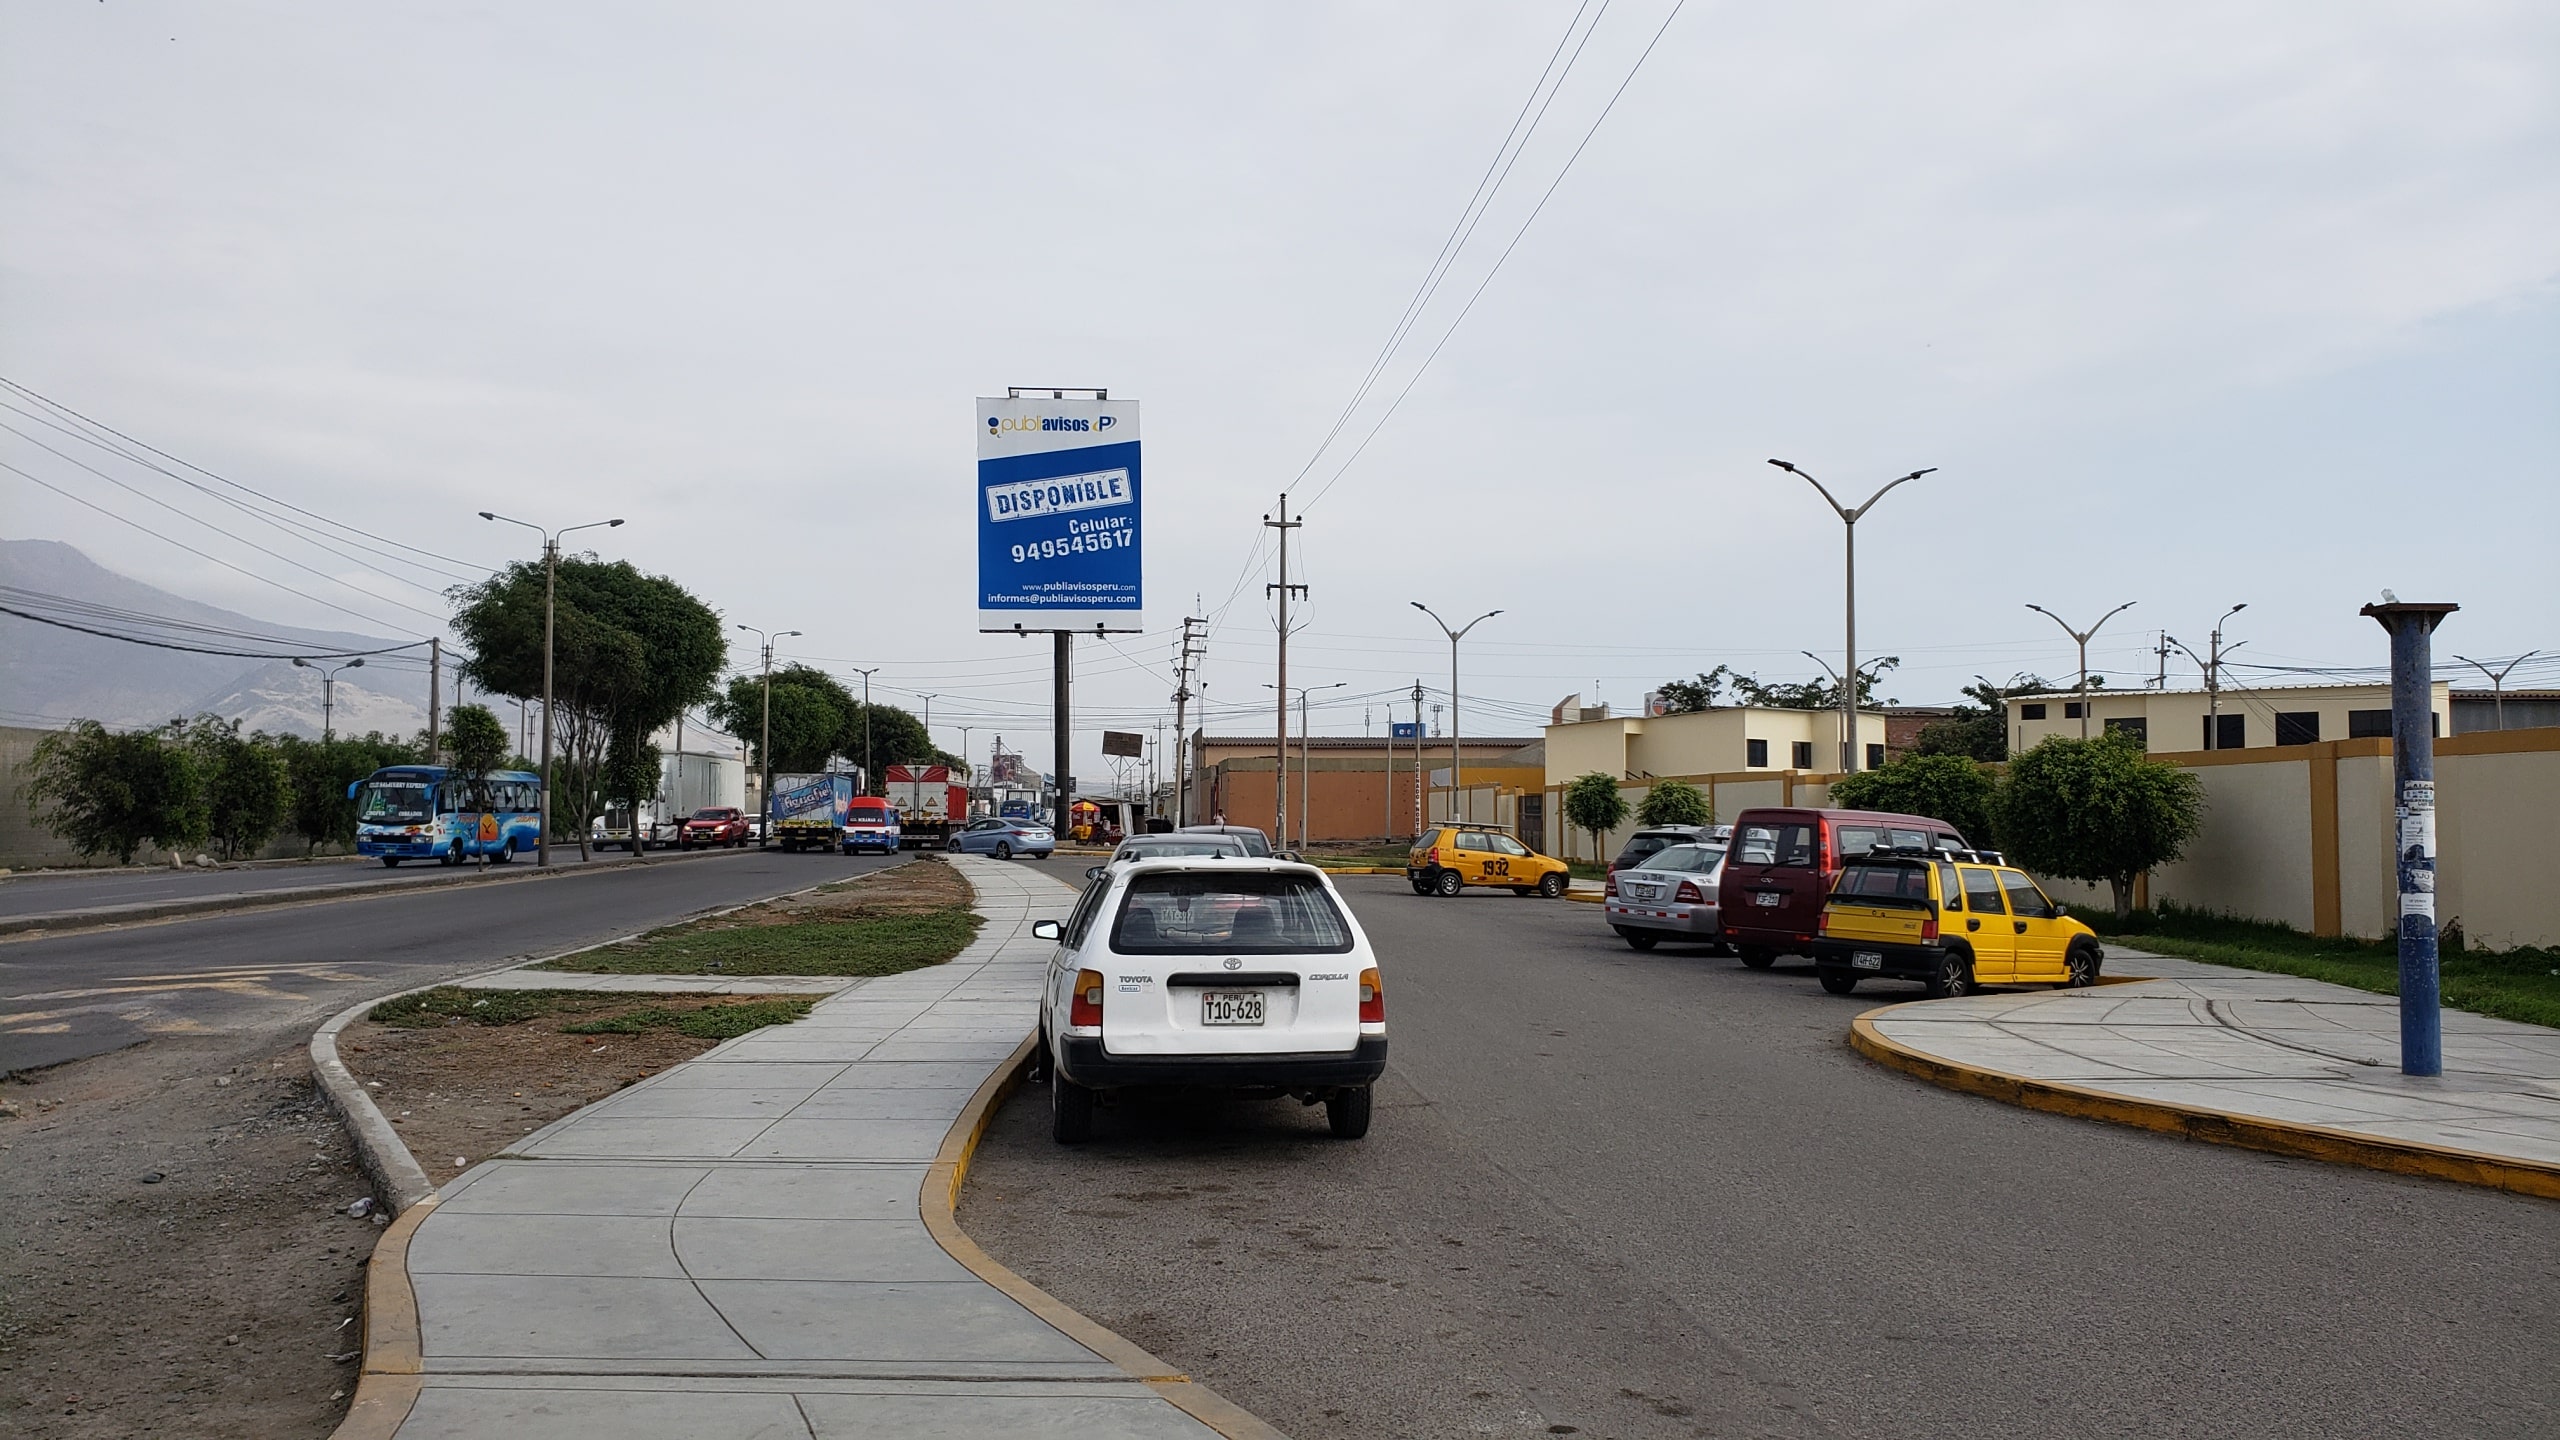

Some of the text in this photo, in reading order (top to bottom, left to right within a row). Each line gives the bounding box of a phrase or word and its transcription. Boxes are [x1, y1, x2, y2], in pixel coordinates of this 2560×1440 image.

[1001, 415, 1090, 433] publiavisos
[996, 477, 1123, 515] DISPONIBLE
[1069, 516, 1133, 535] Celular:
[1011, 529, 1134, 563] 949545617
[1022, 582, 1136, 593] www.publiavisosperu.com
[988, 593, 1136, 604] informes@publiavisosperu.com
[1482, 860, 1509, 876] 1932
[1206, 1001, 1262, 1019] T10-628
